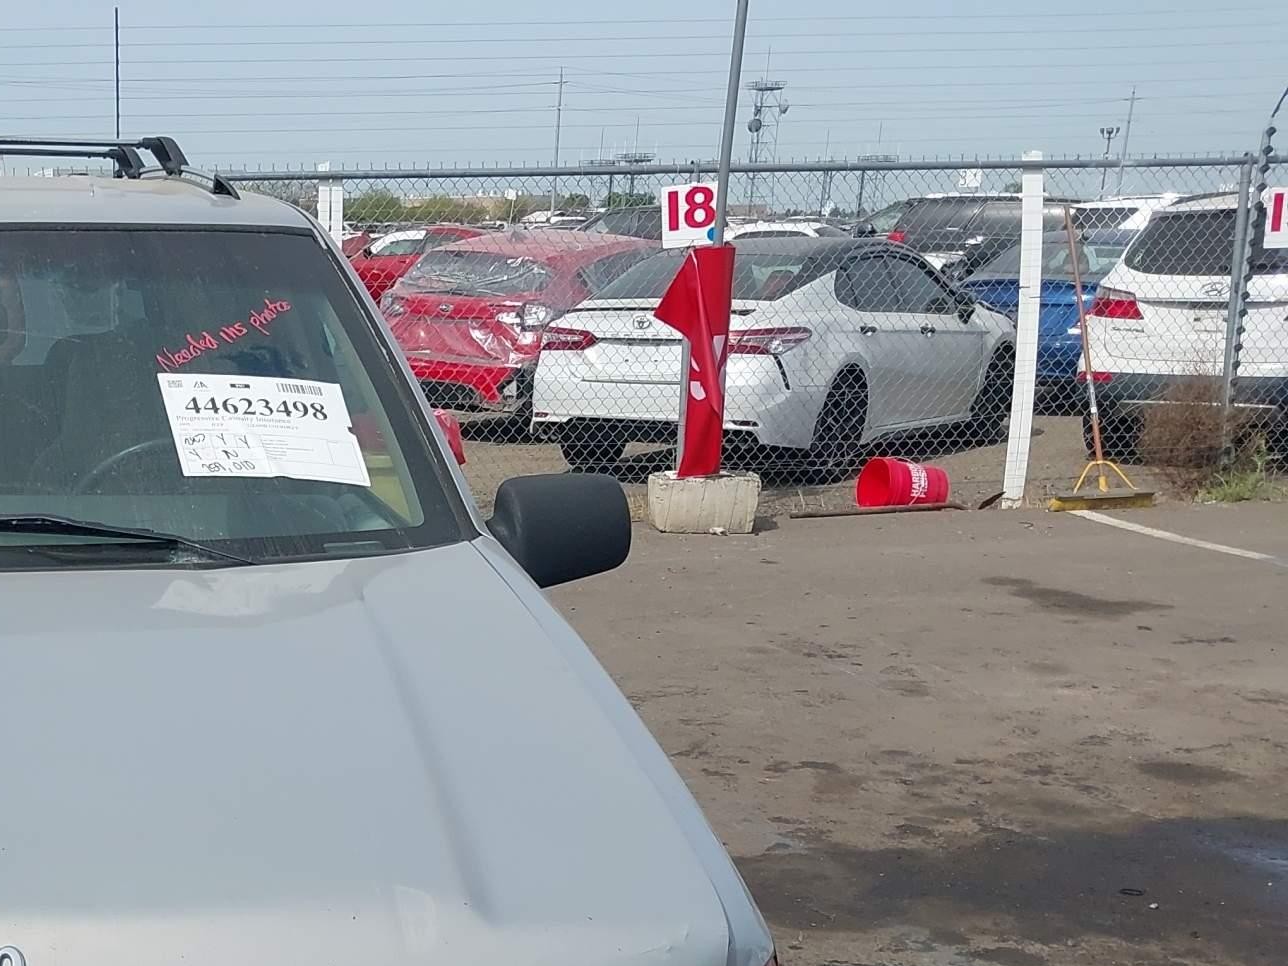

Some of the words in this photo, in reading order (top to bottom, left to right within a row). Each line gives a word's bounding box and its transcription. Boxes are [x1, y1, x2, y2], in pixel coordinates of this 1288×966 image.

[668, 186, 716, 231] 18
[156, 331, 219, 372] Needed
[184, 396, 329, 421] 44623498
